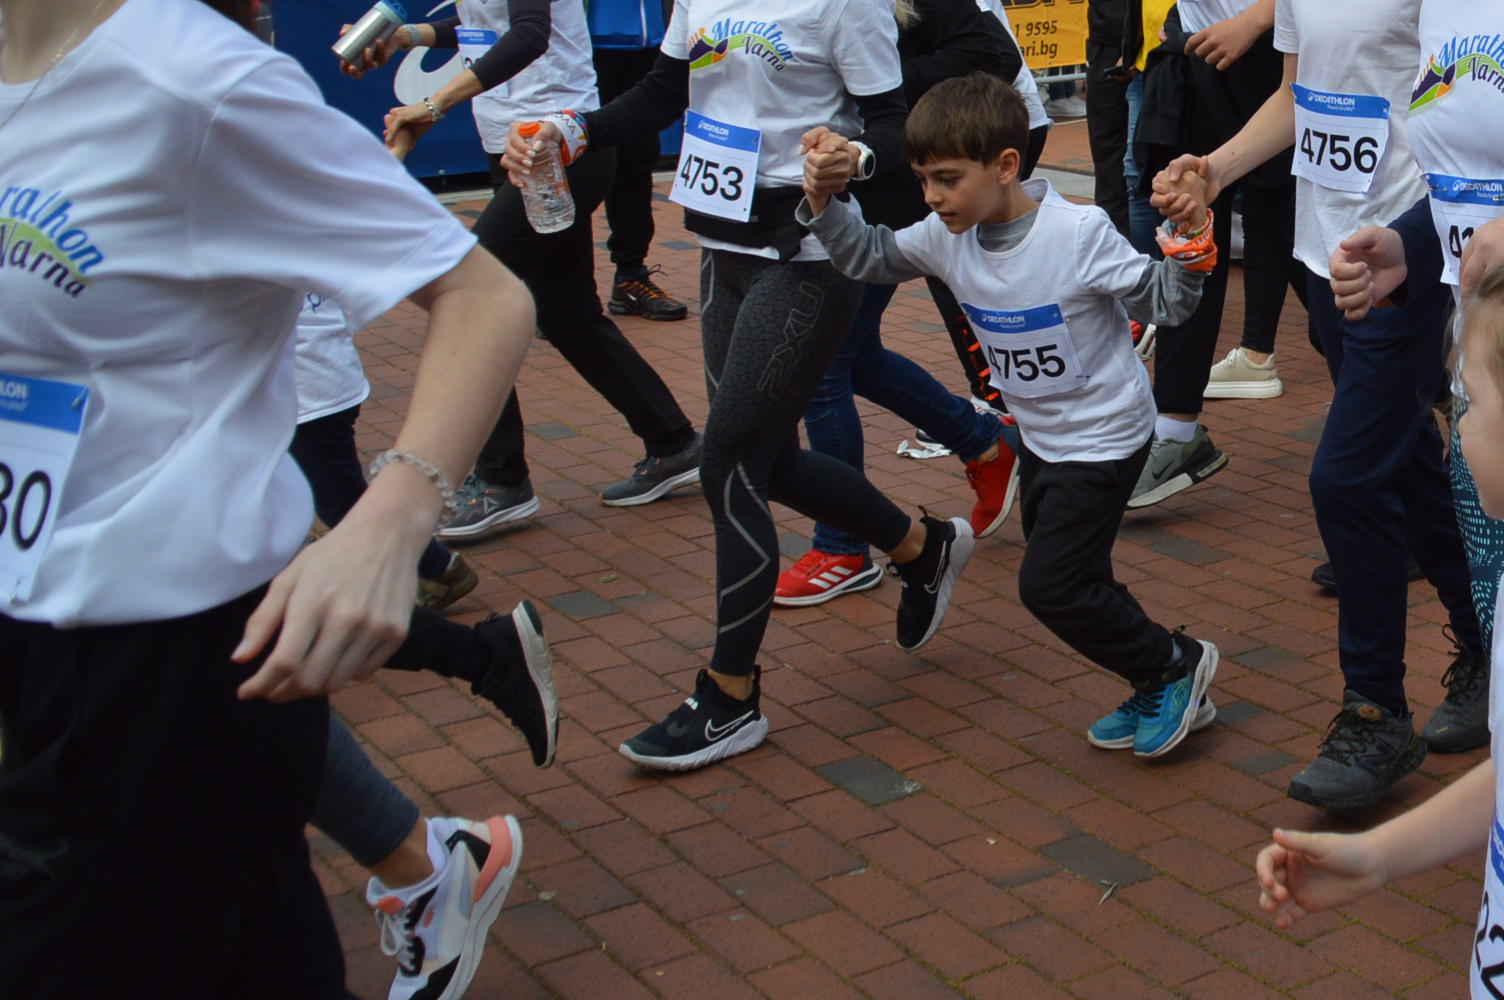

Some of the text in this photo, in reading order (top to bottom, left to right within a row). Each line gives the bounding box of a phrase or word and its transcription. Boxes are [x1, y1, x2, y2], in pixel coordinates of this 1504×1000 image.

[711, 17, 795, 62] Marathon
[1026, 20, 1058, 37] 9595
[741, 35, 785, 72] Varna
[1314, 94, 1355, 106] DECATHLON
[1300, 127, 1379, 174] 4756
[680, 153, 744, 202] 4753
[987, 343, 1066, 382] 4755
